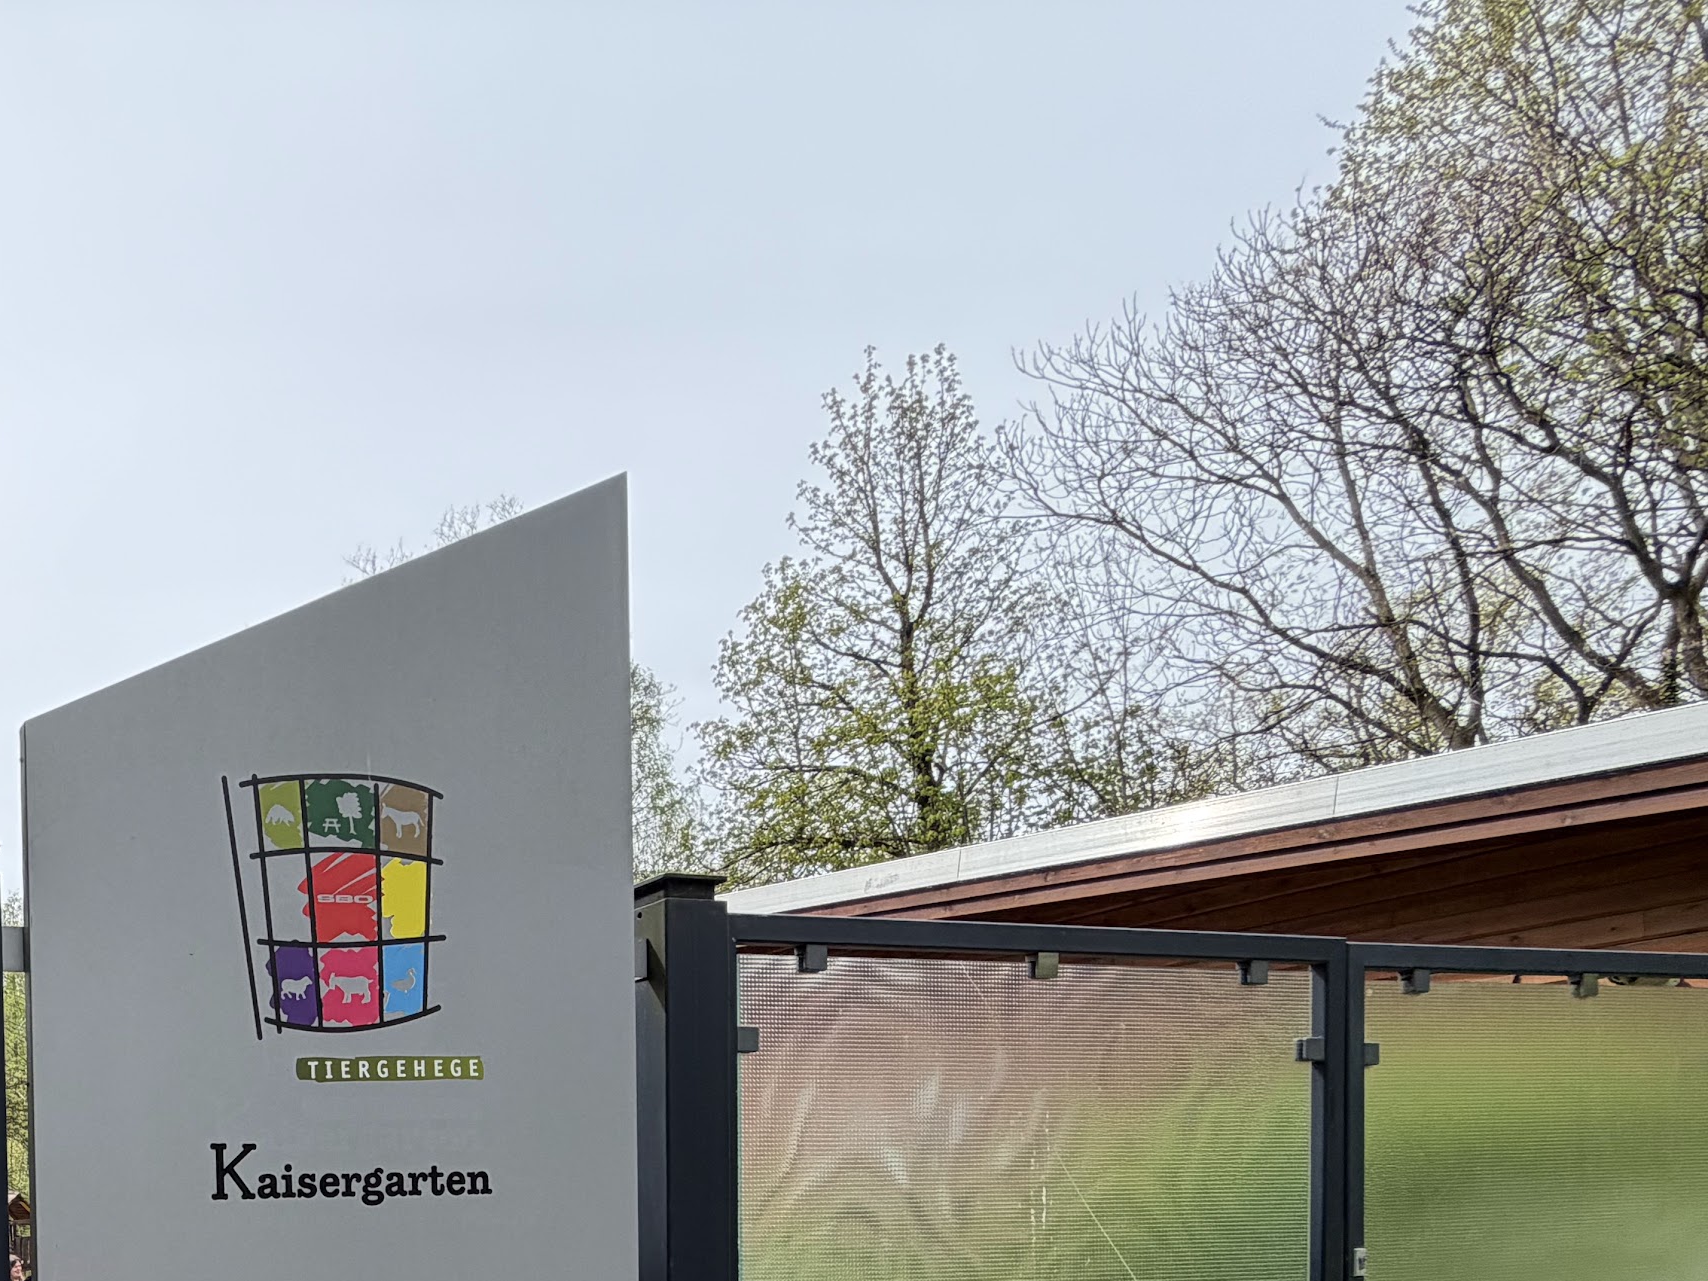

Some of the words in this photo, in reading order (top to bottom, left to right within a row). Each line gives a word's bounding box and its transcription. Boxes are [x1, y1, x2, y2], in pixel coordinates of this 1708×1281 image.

[317, 894, 373, 904] SBO
[308, 1059, 480, 1080] TIERGEHEGE
[210, 1143, 493, 1206] Kaisergarten
